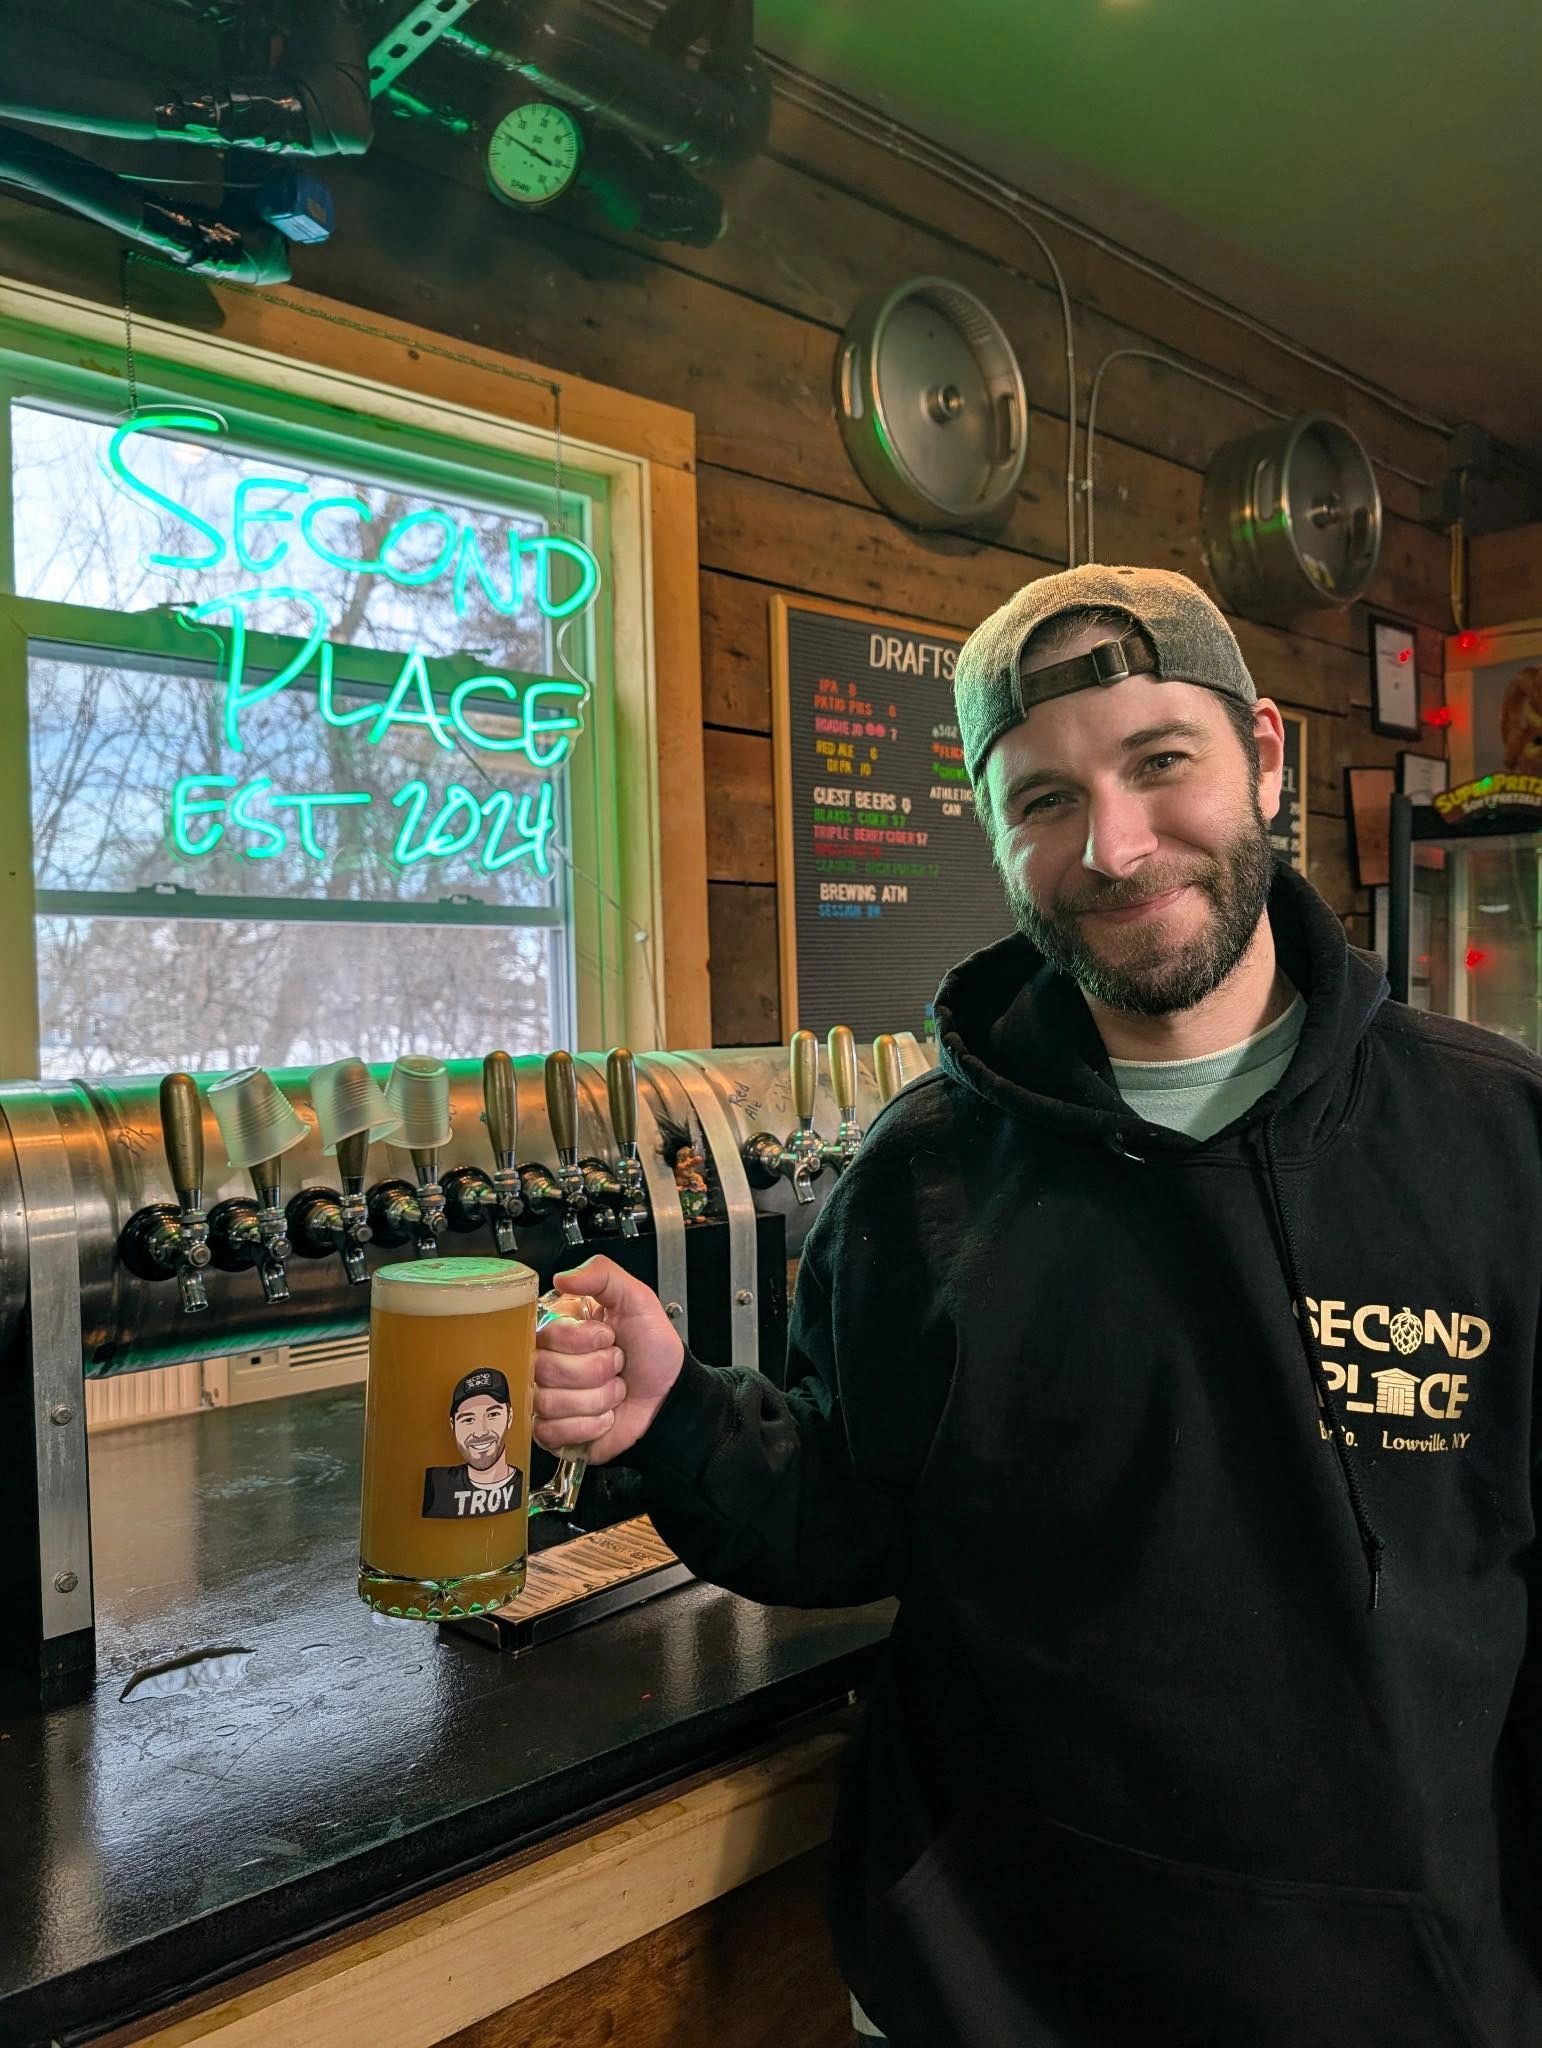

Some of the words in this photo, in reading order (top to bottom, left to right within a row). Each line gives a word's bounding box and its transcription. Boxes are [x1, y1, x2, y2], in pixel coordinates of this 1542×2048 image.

[109, 415, 597, 618] SECOND
[869, 633, 956, 680] DRAFTS
[190, 586, 584, 767] PLACE
[814, 787, 852, 807] GUEST
[855, 790, 896, 812] BEERS
[171, 775, 372, 859] EST
[393, 781, 553, 875] 2024
[820, 883, 877, 902] BREWING
[882, 885, 908, 904] ATM
[728, 1080, 751, 1107] Red
[744, 1099, 762, 1120] Ale
[1382, 1430, 1449, 1452] Lowville,
[1451, 1432, 1471, 1450] NY
[454, 1484, 514, 1516] TROY
